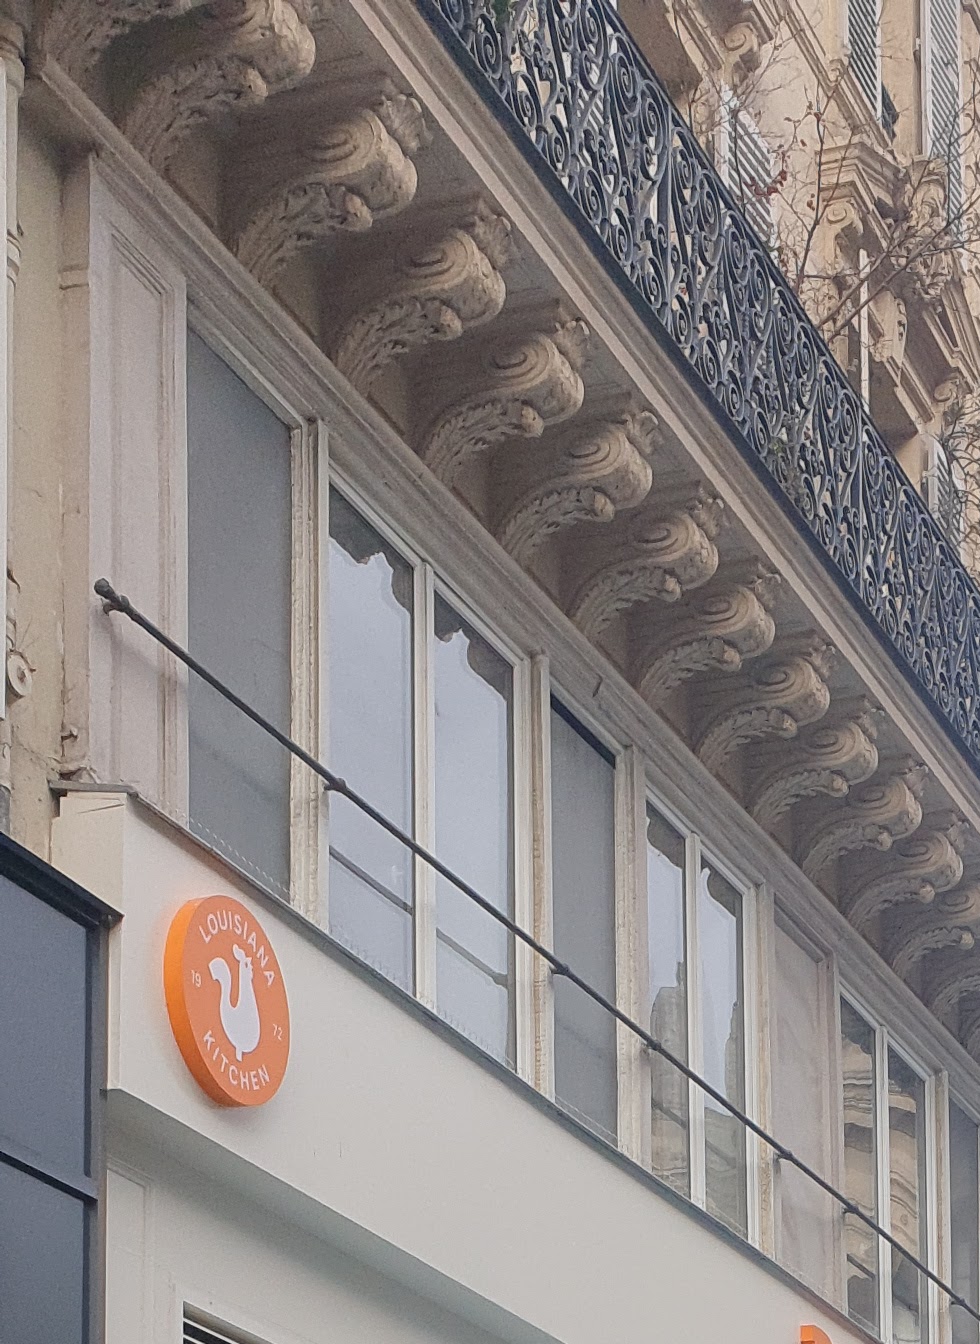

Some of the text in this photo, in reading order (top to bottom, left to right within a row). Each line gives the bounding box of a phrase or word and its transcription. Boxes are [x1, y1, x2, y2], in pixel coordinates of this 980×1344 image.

[199, 910, 275, 987] LOUISIANA
[191, 970, 283, 1041] 19 72
[204, 1030, 270, 1091] KITCHEN
